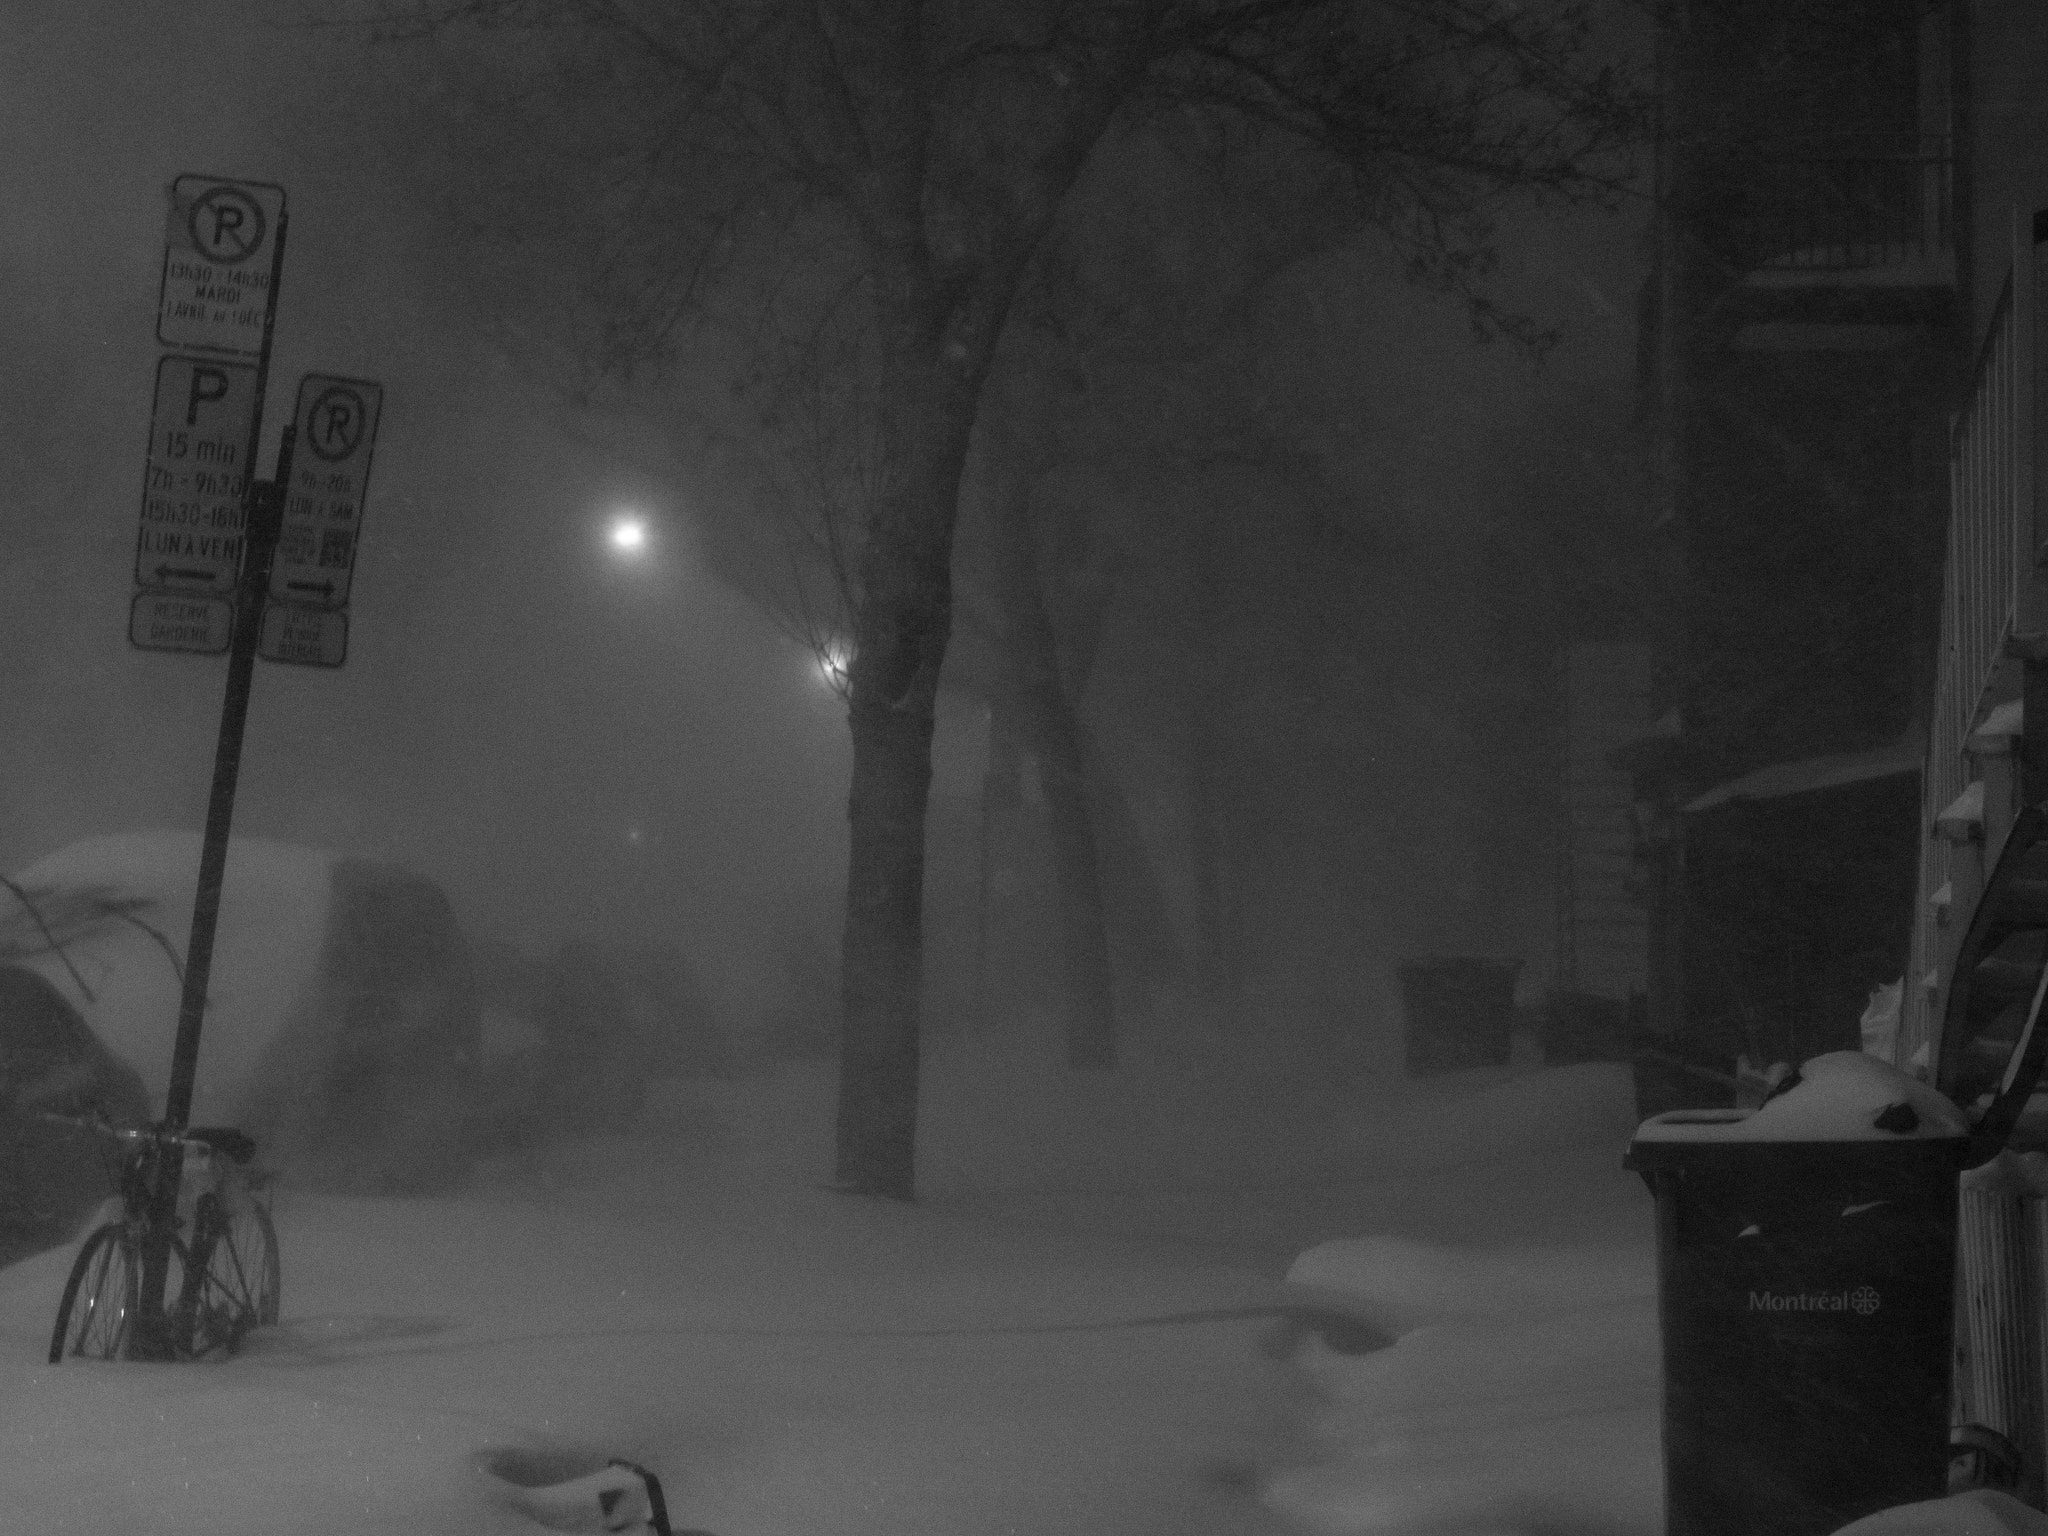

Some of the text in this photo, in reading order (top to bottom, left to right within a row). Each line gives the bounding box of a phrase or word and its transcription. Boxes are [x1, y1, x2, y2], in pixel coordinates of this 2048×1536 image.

[195, 285, 241, 305] MARDI
[186, 366, 229, 426] P
[166, 432, 236, 465] 15 min
[151, 466, 173, 490] 7h
[195, 471, 243, 497] 9h30
[144, 530, 181, 554] LUN
[200, 535, 236, 560] VEN
[1748, 1289, 1849, 1311] Montréal
